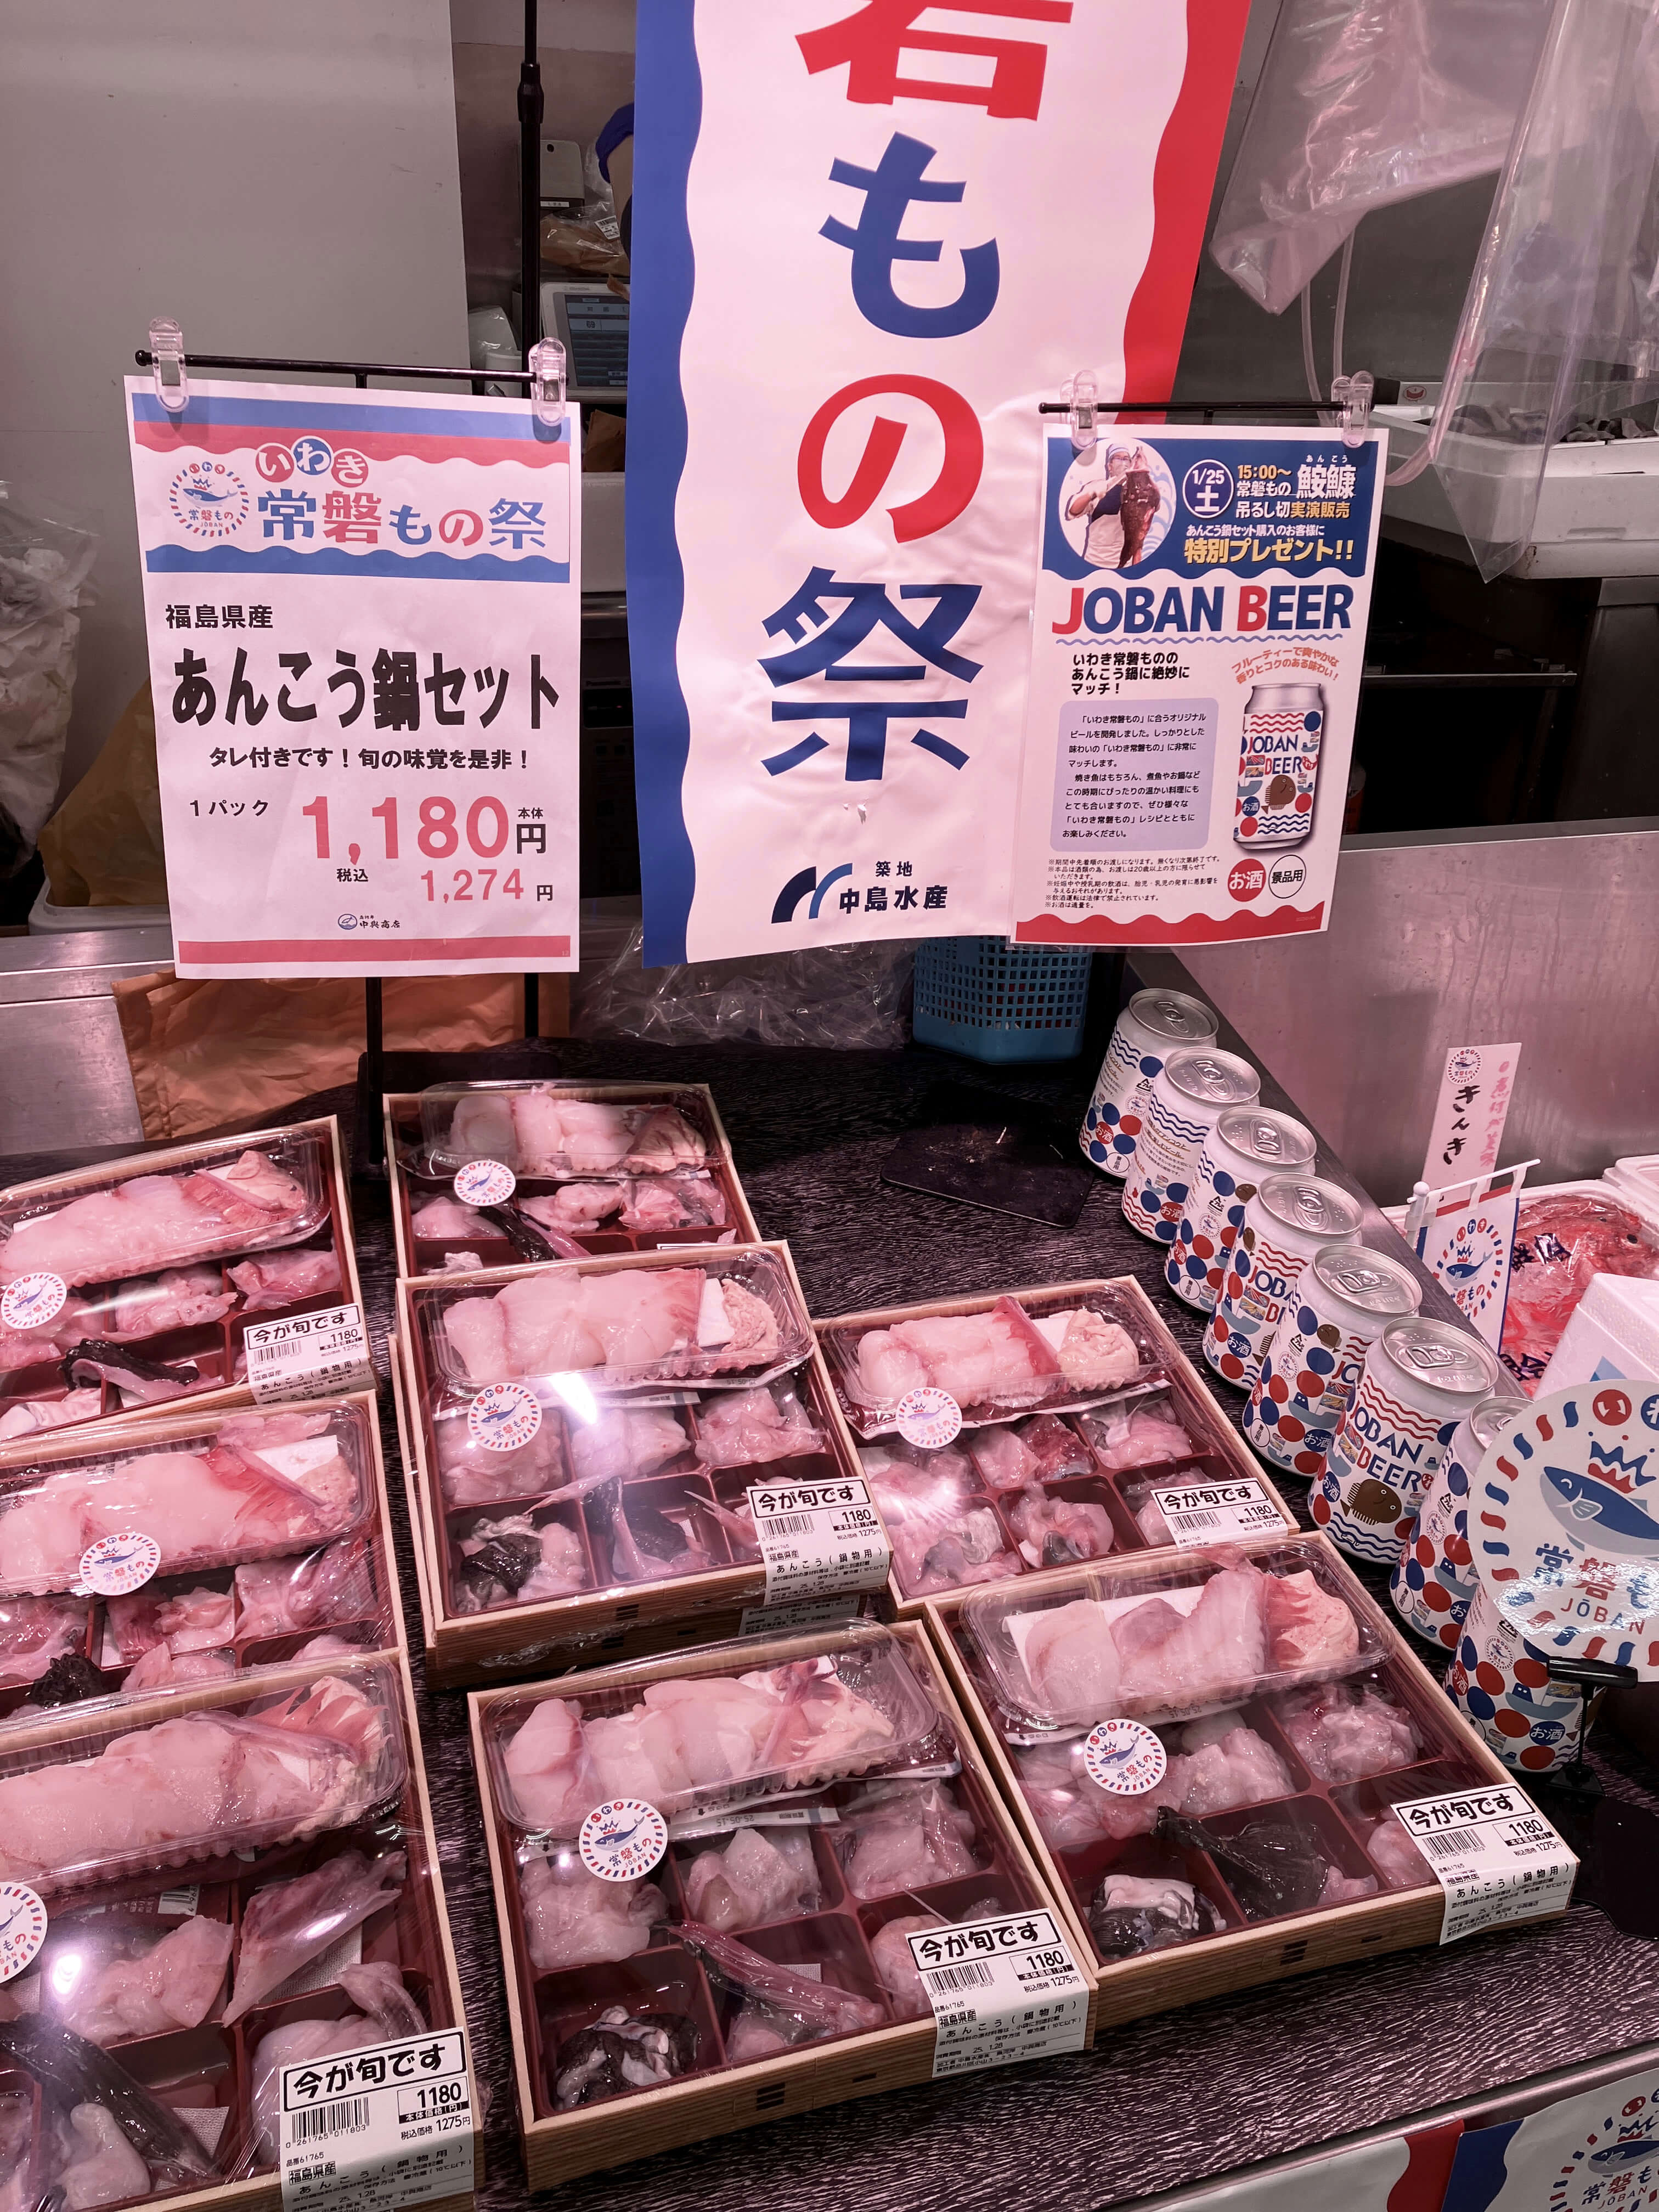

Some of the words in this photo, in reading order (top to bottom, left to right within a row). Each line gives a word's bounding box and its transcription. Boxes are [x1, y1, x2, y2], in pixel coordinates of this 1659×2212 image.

[258, 441, 366, 485] いわき
[1192, 469, 1225, 485] 1/25
[1296, 464, 1356, 499] 鮟鱇
[1237, 481, 1291, 497] 常磐もの
[1195, 486, 1220, 512] 土
[1236, 501, 1350, 518] 吊るし切実演販売
[258, 489, 546, 549] 常磐もの祭
[1186, 524, 1325, 537] あんこう鍋セット購入のお客様に
[165, 604, 273, 629] 福島県産
[1052, 586, 1224, 634] JOBAN
[1237, 584, 1354, 631] BEER
[1073, 652, 1178, 665] いわき常磐ものの
[1232, 647, 1339, 673] フルーティーで爽やかな
[1071, 667, 1189, 680] あんこう鍋に絶妙に
[172, 647, 559, 731] あんこう鍋セット
[1071, 683, 1120, 695] マッチ！
[1081, 713, 1206, 724] 「いわき常磐もの」に合うオリジナル
[1070, 727, 1205, 739] ビールを開発しました。しっかりとした
[1069, 742, 1197, 754] 味わいの「いわき常磐もの」に非常に
[1248, 734, 1299, 754] JOBAN
[1068, 759, 1118, 768] マッチします。
[1265, 755, 1302, 775] BEER
[1075, 771, 1201, 782] 焼き魚はもちろん、煮魚やお鍋など
[1066, 786, 1199, 796] この時期にぴったりの温かい料理にも
[518, 808, 543, 820] 本体
[1065, 800, 1188, 810] とても合いますので、ぜひ様々な
[1243, 802, 1259, 811] お酒
[1066, 814, 1195, 824] 「いわき常磐もの」レシピとともに
[302, 795, 509, 865] 1,180
[516, 823, 546, 854] 円
[1062, 830, 1127, 838] お楽しみください。
[337, 868, 369, 883] 税込
[875, 861, 913, 877] 築地
[1272, 870, 1303, 884] 景品用
[421, 868, 523, 903] 1,274
[537, 884, 553, 901] 円
[1229, 870, 1263, 890] お酒
[839, 885, 947, 915] 中島水産
[1096, 1125, 1111, 1142] お酒
[1443, 1085, 1480, 1165] きんき
[253, 1312, 347, 1343] 今が旬です
[330, 1329, 358, 1343] 1180
[1228, 1336, 1251, 1356] お酒
[1305, 1433, 1331, 1448] お酒
[1350, 1400, 1424, 1464] JOBAN
[1356, 1446, 1422, 1492] BEER
[1323, 1475, 1339, 1499] お酒
[758, 1485, 854, 1512] 今が旬です
[1164, 1486, 1251, 1509] 今が旬です
[842, 1509, 871, 1523] 1180
[1244, 1505, 1272, 1517] 1180
[858, 1529, 882, 1537] 1275円
[769, 1550, 799, 1562] 福島県産
[1531, 1728, 1564, 1740] お酒
[1117, 1755, 1152, 1782] 常磐もの
[1409, 1793, 1514, 1829] 今が旬です
[1509, 1819, 1543, 1836] 1180
[609, 1838, 652, 1867] 常磐もの
[1536, 1841, 1562, 1852] 1275円
[919, 1921, 1038, 1962] 今が旬です
[1026, 1950, 1064, 1970] 1180
[1024, 1982, 1049, 1993] 税込価格
[1051, 1975, 1080, 1987] 1275円
[934, 2001, 964, 2013] 品番61765
[939, 2010, 976, 2029] 福島県産
[293, 2044, 445, 2098] 今が旬です
[417, 2083, 461, 2108] 1180
[297, 2133, 329, 2146] 261765
[335, 2124, 366, 2137] 011803
[401, 2125, 432, 2140] 税込価格
[436, 2115, 470, 2131] 1275円
[286, 2152, 324, 2166] 品番61765
[290, 2162, 336, 2184] 福島県産
